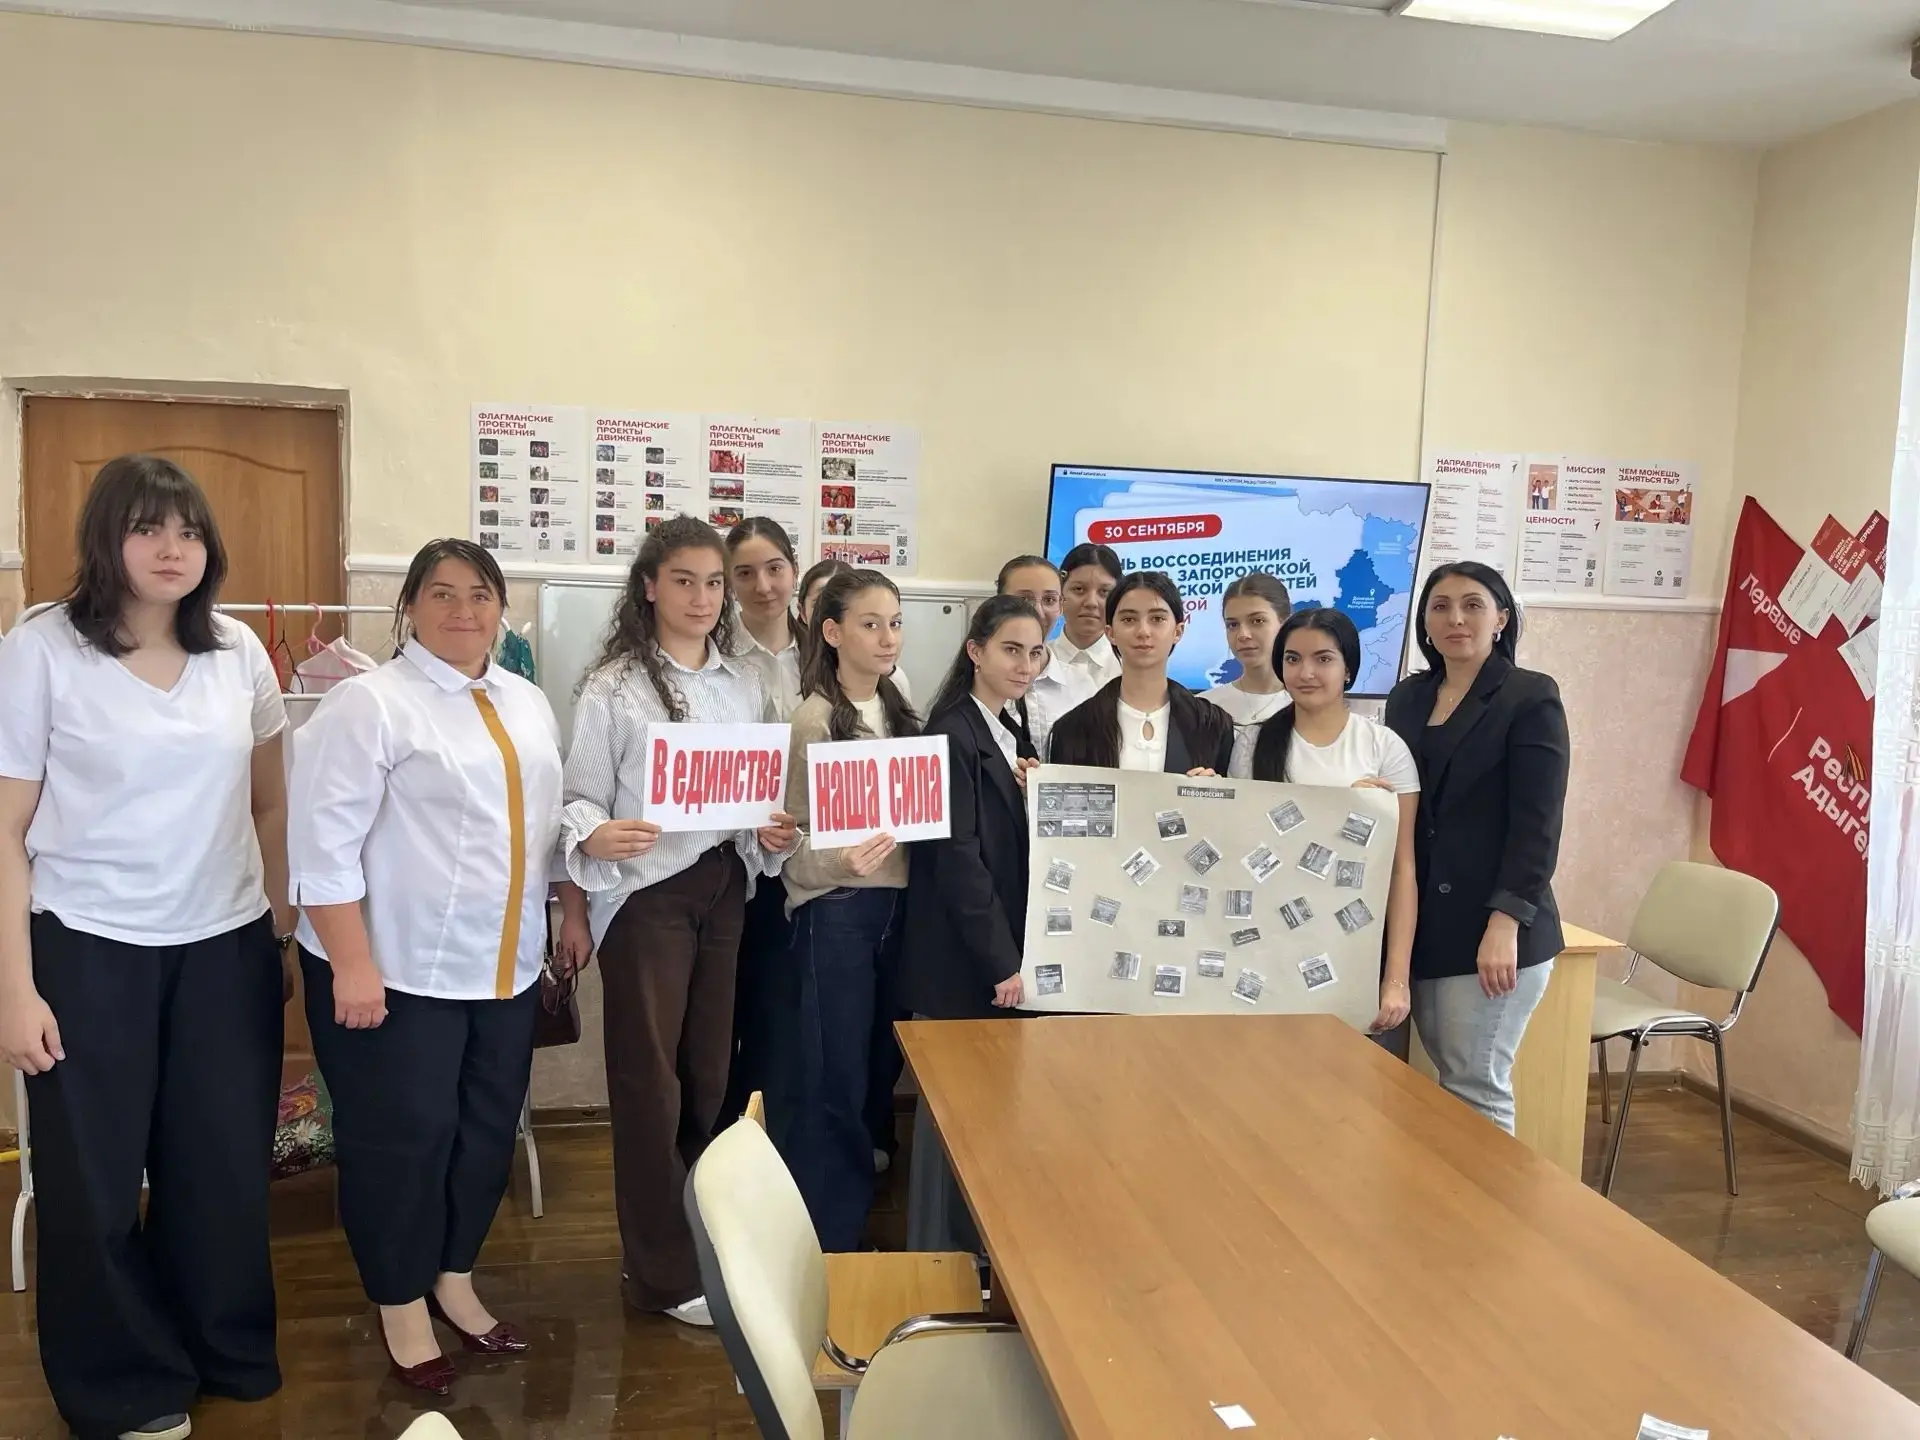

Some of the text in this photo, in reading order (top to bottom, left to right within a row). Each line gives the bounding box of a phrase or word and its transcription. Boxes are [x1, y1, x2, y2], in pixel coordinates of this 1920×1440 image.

[478, 412, 554, 424] ФЛАГМАНСКИЕ
[478, 420, 527, 430] ПРОЕКТЫ
[596, 419, 670, 430] ФЛАГМАНСКИЕ
[478, 428, 536, 437] ДВИЖЕНИЯ
[596, 426, 643, 435] ПРОЕКТЫ
[709, 424, 781, 436] ФЛАГМАНСКИЕ
[596, 433, 652, 443] ДВИЖЕНИЯ
[709, 432, 755, 440] ПРОЕКТЫ
[822, 432, 891, 442] ФЛАГМАНСКИЕ
[709, 439, 764, 448] ДВИЖЕНИЯ
[822, 440, 866, 448] ПРОЕКТЫ
[821, 447, 874, 456] ДВИЖЕНИЯ
[1437, 458, 1501, 470] НАПРАВЛЕНИЯ
[1436, 466, 1487, 475] ДВИЖЕНИЯ
[1566, 466, 1606, 474] МИССИЯ
[1639, 468, 1680, 478] МОЖЕШЬ
[1618, 475, 1661, 483] ЗАНЯТЬСЯ
[1526, 516, 1576, 525] ЦЕННОСТИ
[1104, 520, 1205, 538] 30 СЕНТЯБРЯ
[1860, 516, 1880, 543] ЕРВЫЕ
[1141, 548, 1291, 569] ВОССОЕДИНЕНИЯ
[1177, 558, 1311, 582] ЗАПОРОЖСКОЙ
[1739, 572, 1801, 645] Первые
[651, 738, 782, 814] В единстве
[815, 754, 943, 832] наша сила
[1181, 788, 1224, 798] Новороссия
[1791, 764, 1870, 860] Адыге
